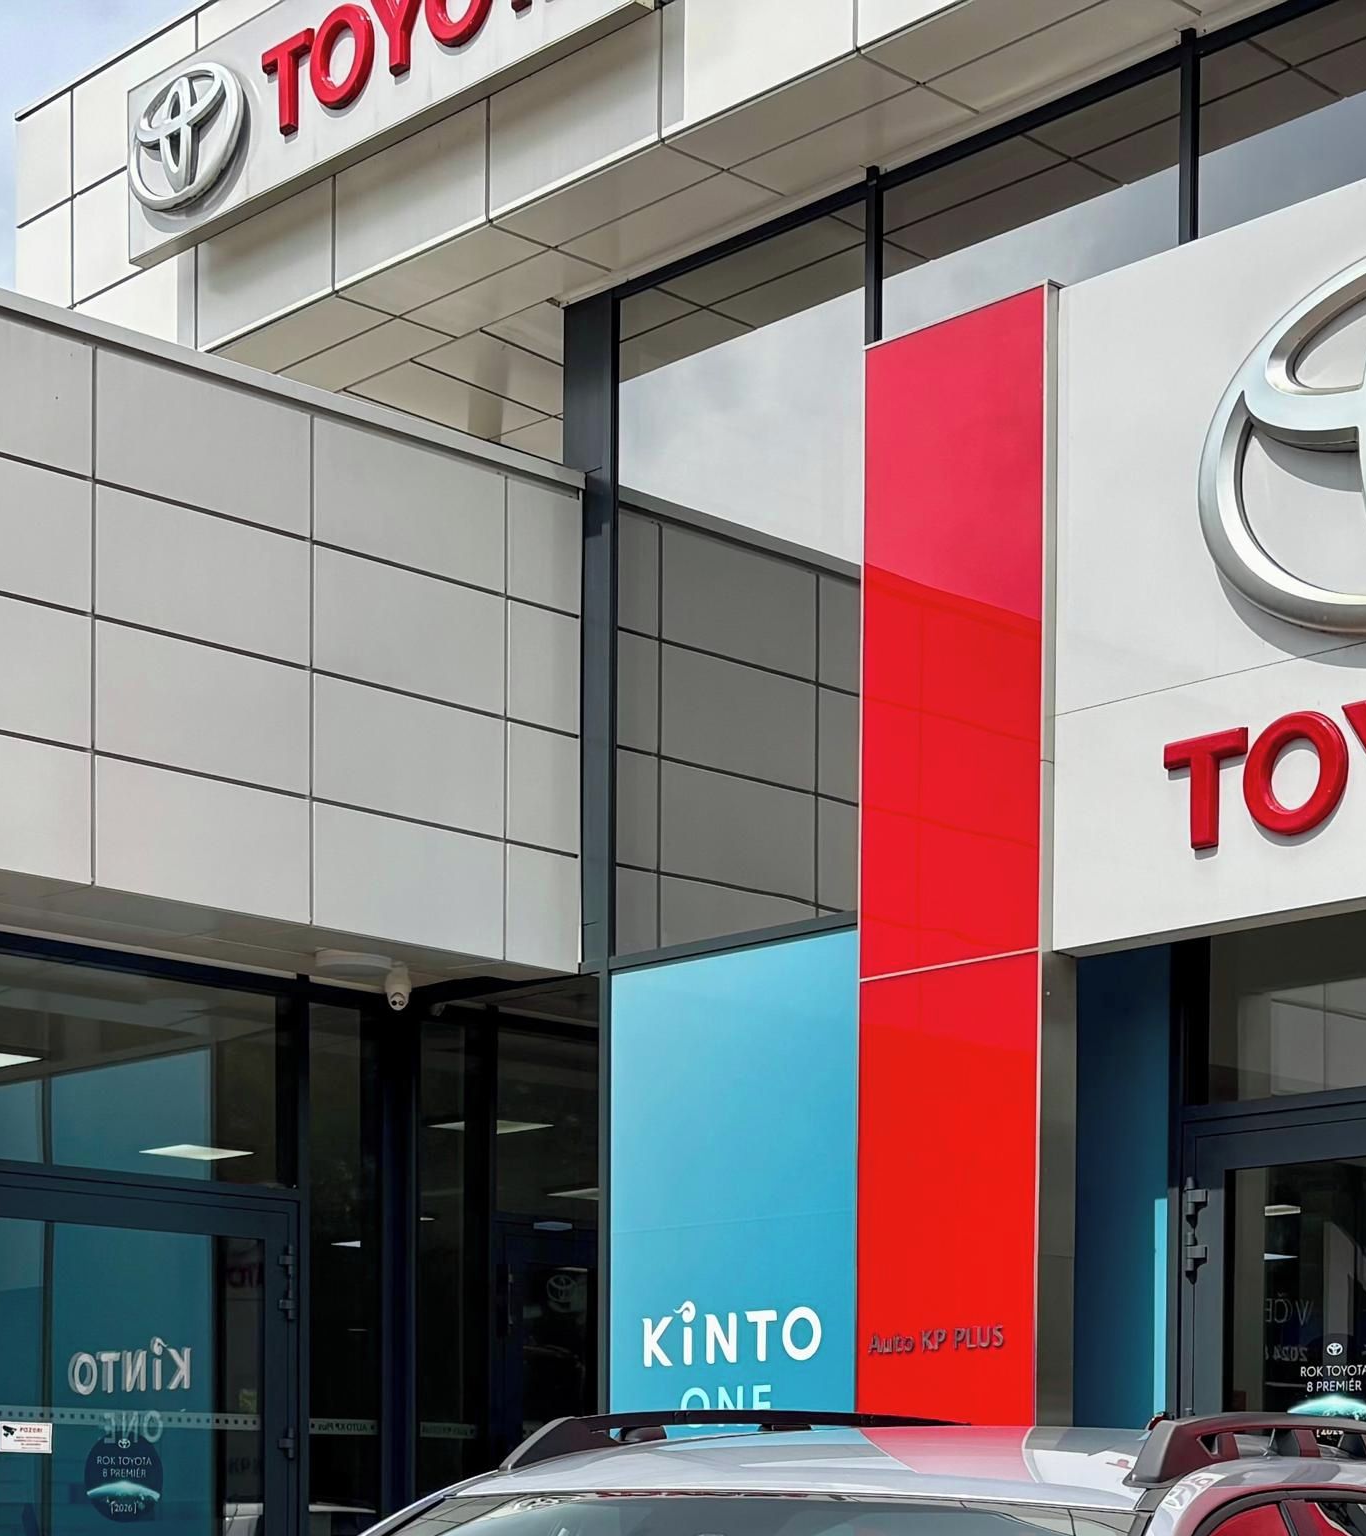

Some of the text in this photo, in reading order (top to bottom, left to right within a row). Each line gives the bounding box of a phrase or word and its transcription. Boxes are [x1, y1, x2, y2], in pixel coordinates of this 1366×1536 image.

[262, 0, 533, 137] TOY
[921, 1330, 946, 1351] KP
[953, 1325, 1005, 1350] PLUS
[1300, 1365, 1323, 1378] ROK
[1306, 1378, 1362, 1392] 8 PREMIÉR
[96, 1455, 152, 1466] ROK TOYOTA
